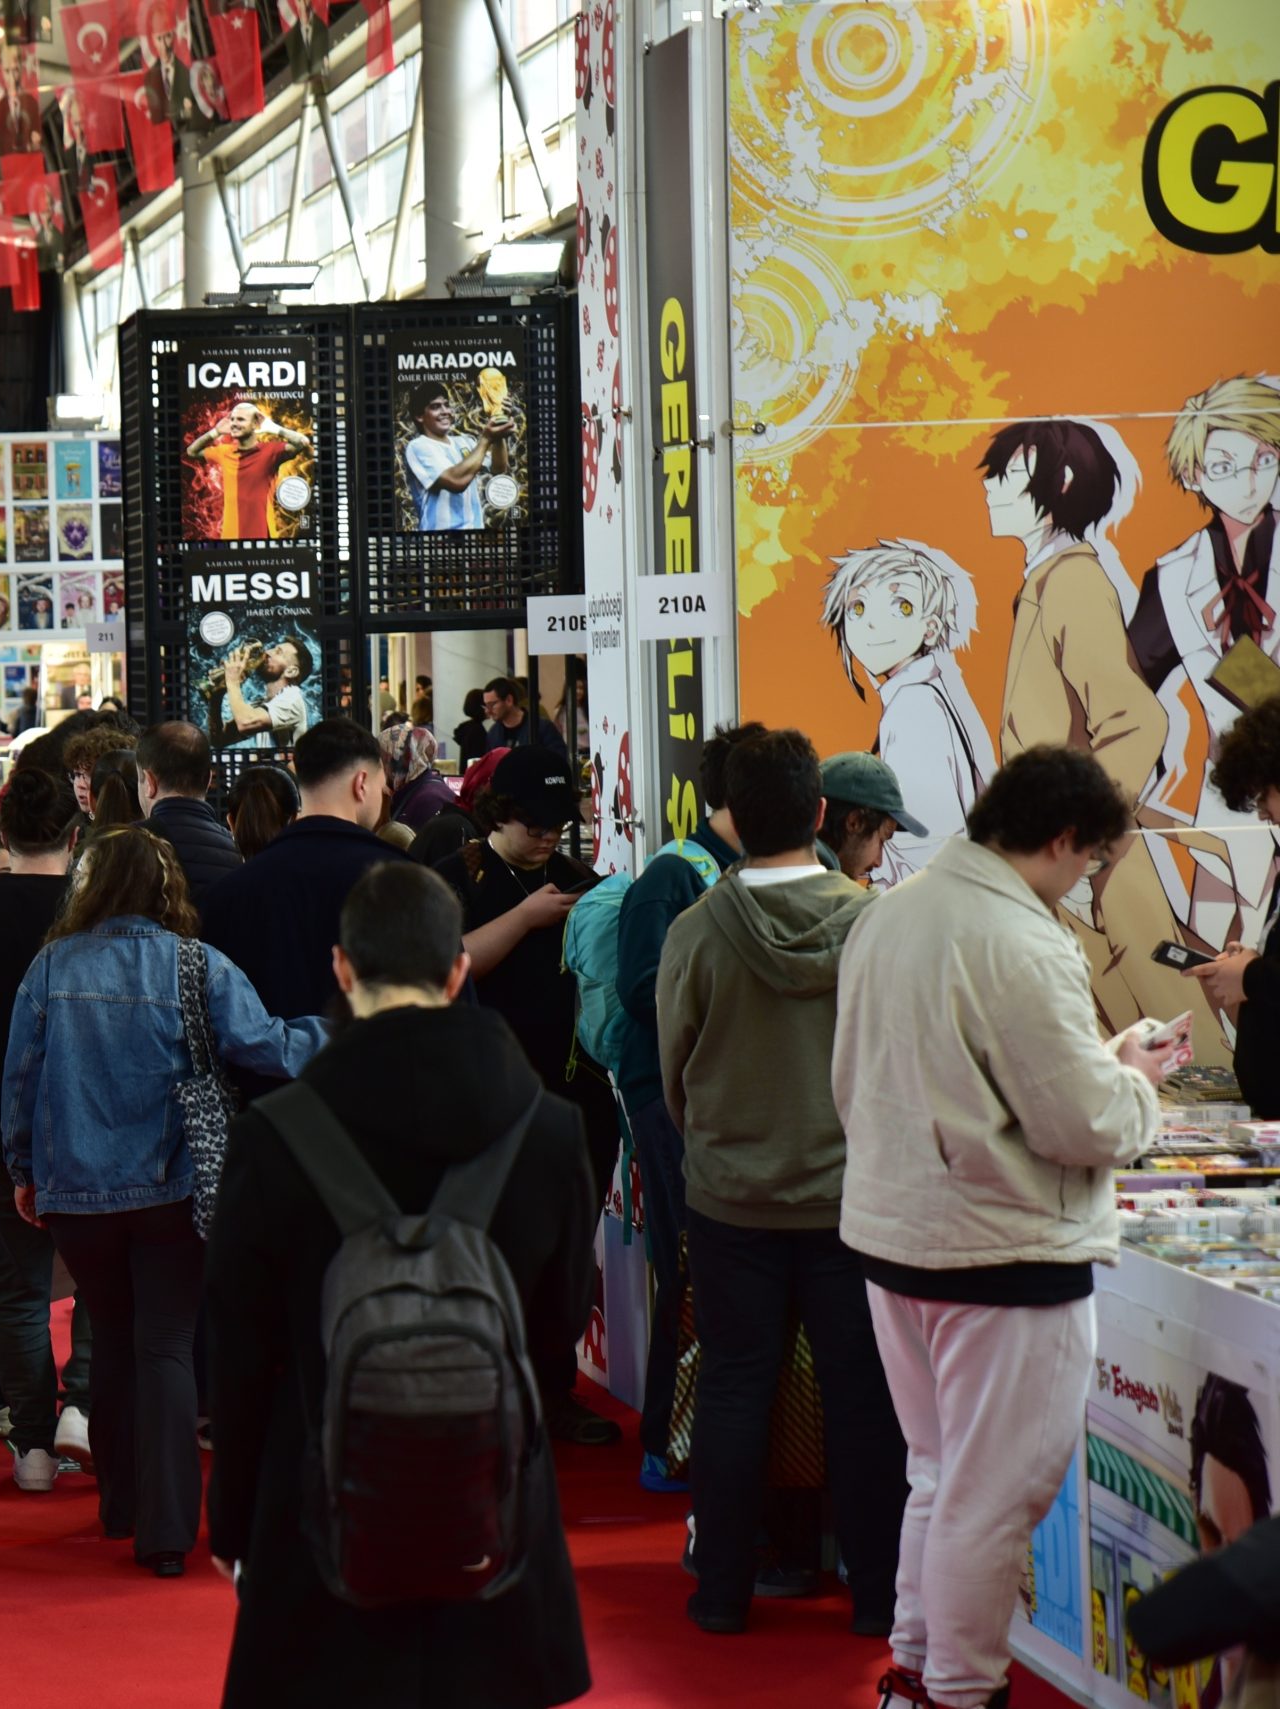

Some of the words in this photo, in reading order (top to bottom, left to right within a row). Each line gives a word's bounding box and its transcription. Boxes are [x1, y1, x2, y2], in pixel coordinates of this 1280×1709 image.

[1145, 84, 1280, 250] G
[202, 348, 239, 356] SAHANIN
[243, 347, 292, 355] YILDIZLARI
[397, 350, 517, 370] MARADONA
[187, 360, 306, 389] ICARDI
[264, 390, 305, 400] KOYUNCU
[205, 559, 243, 568] SAHANIN
[247, 558, 295, 566] YILDIZLARI
[191, 571, 311, 602] MESSI
[246, 608, 275, 617] HARRY
[658, 594, 706, 615] 210A
[97, 631, 115, 643] 211
